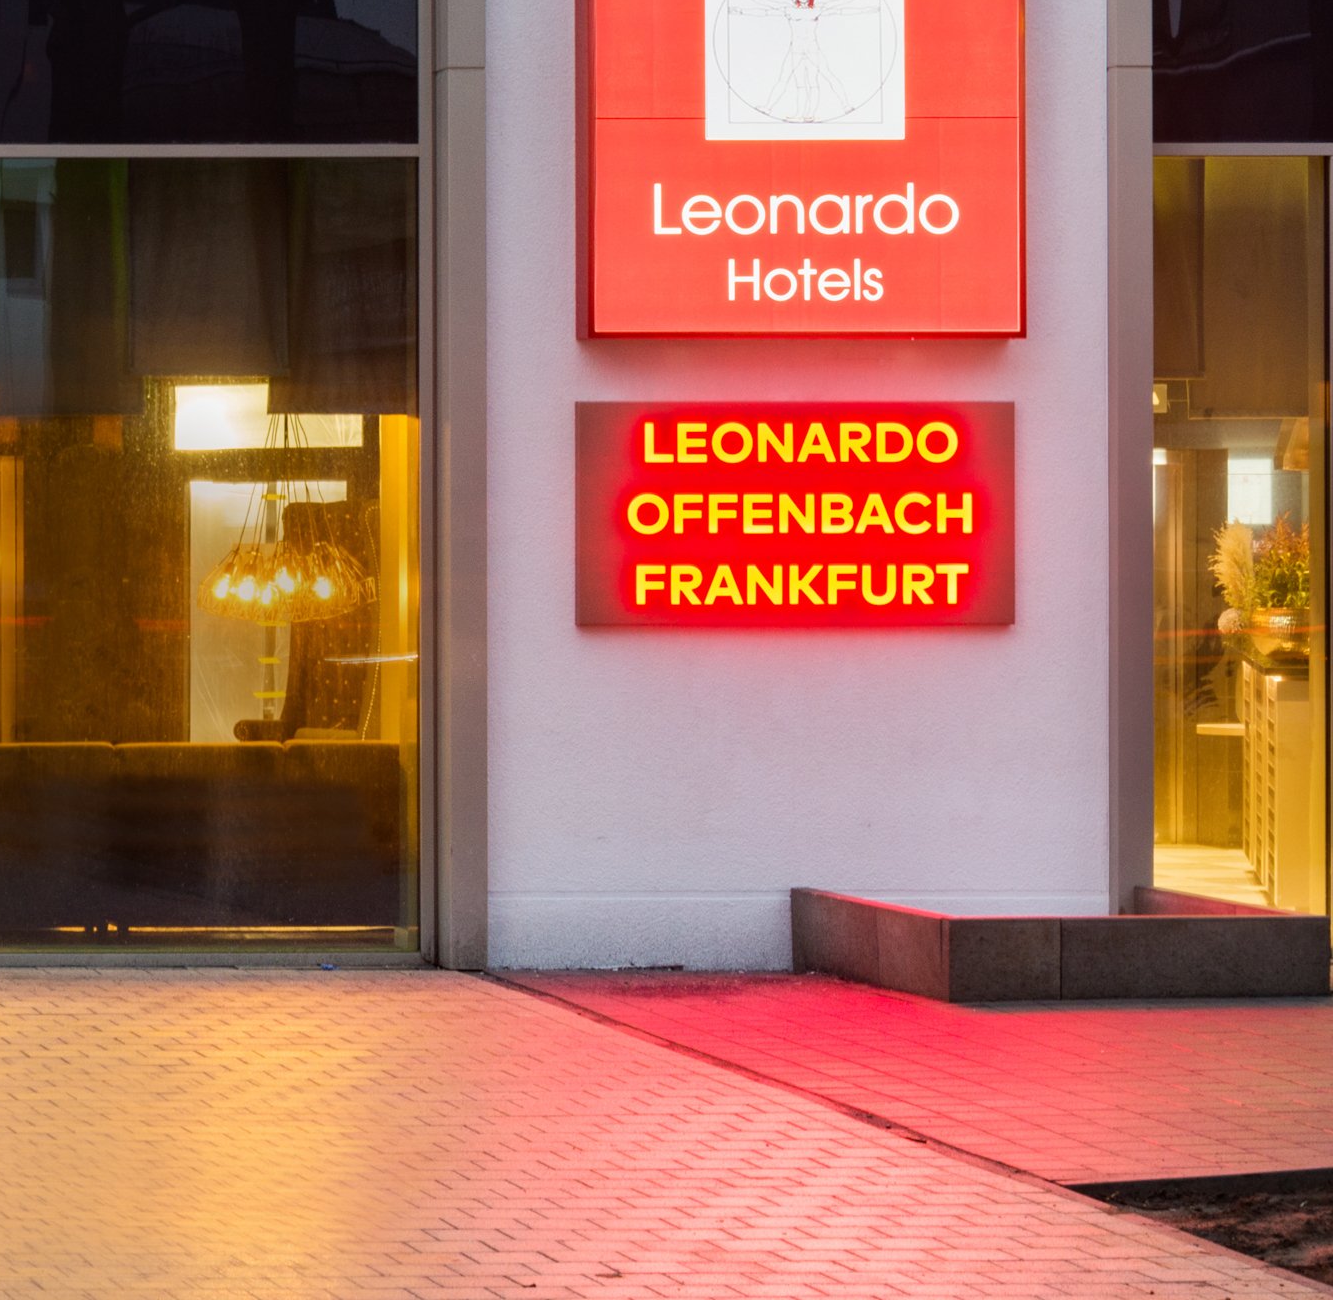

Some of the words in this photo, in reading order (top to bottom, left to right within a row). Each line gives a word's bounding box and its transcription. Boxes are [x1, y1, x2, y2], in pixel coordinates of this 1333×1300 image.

[653, 181, 960, 236] Leonardo
[727, 257, 885, 302] Hotels
[643, 420, 960, 465] LEONARDO
[626, 491, 974, 536] OFFENBACH
[634, 562, 970, 607] FRANKFURT
